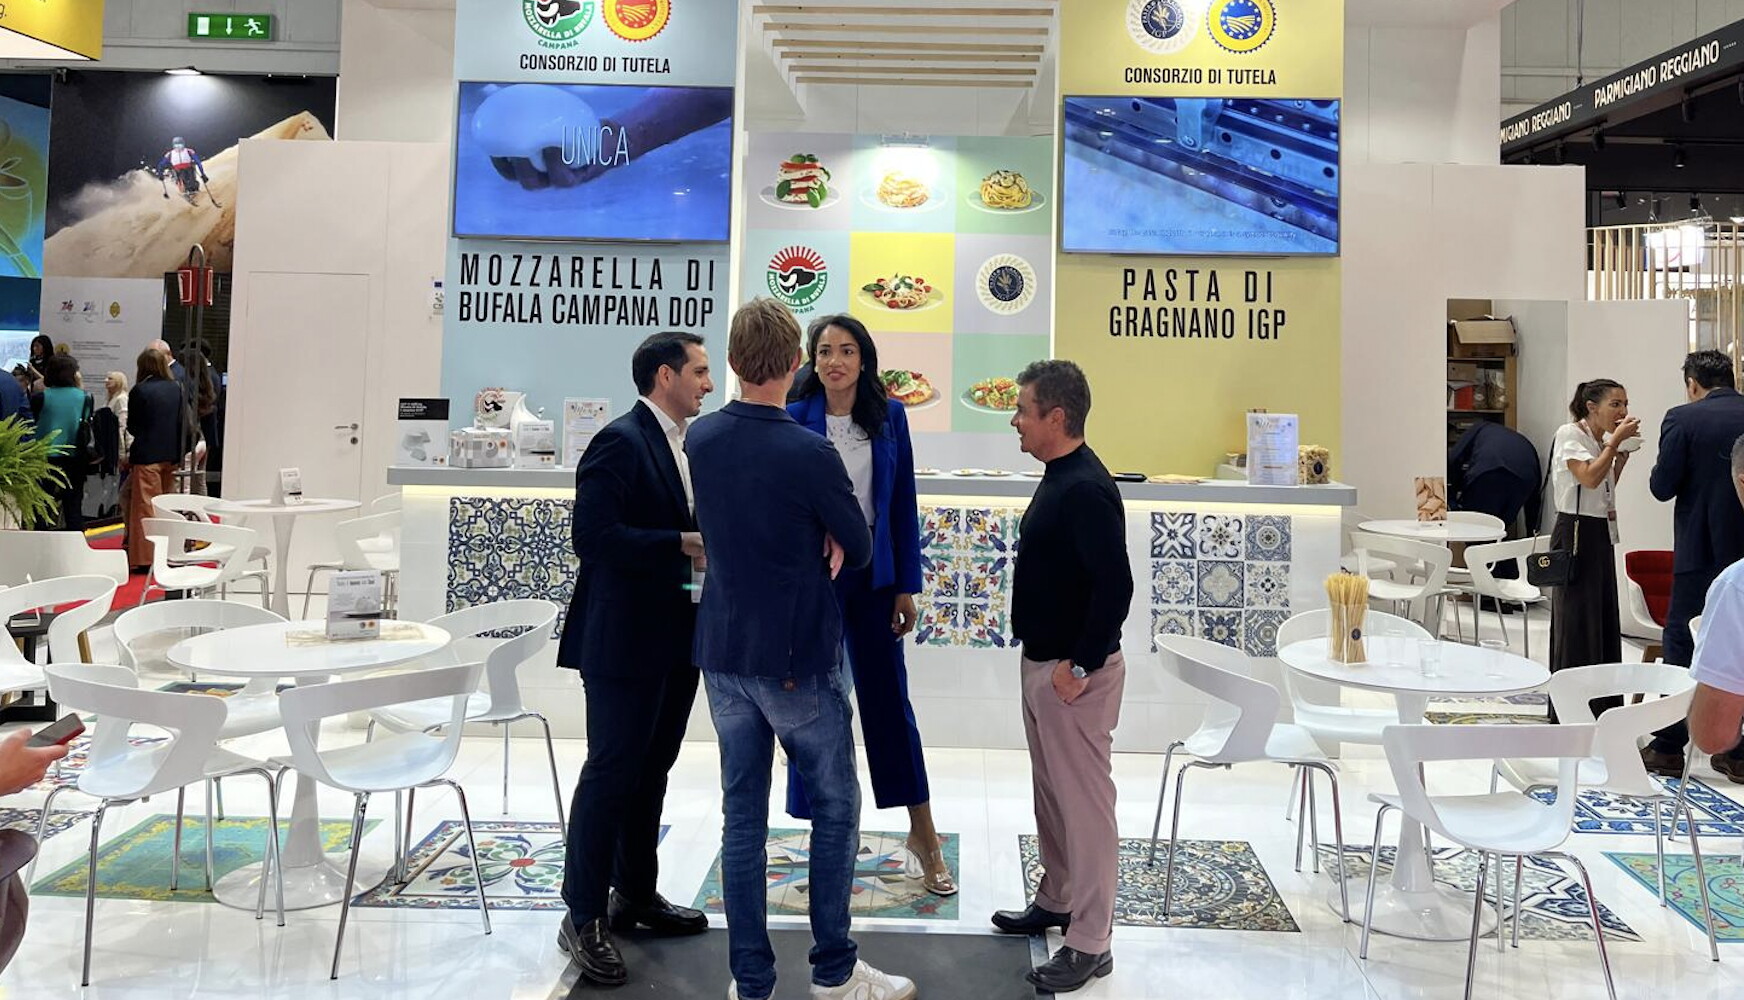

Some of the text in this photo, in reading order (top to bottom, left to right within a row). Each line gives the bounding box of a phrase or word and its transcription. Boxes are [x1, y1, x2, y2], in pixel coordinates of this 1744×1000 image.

[538, 39, 579, 49] CAMPANA
[520, 54, 670, 73] CONSORZIO DI TUTELA
[1125, 67, 1276, 85] CONSORZIO DI TUTELA
[1594, 40, 1719, 109] PARMIGIANO REGGIANO
[1500, 101, 1571, 144] MIGIANO REGGIANO
[561, 125, 630, 166] UNICA
[460, 253, 714, 291] MOZZARELLA DI
[1123, 268, 1272, 303] PASTA DI
[459, 291, 713, 327] BUFALA CAMPANA DOP
[1109, 306, 1286, 340] GRAGNANO IGP
